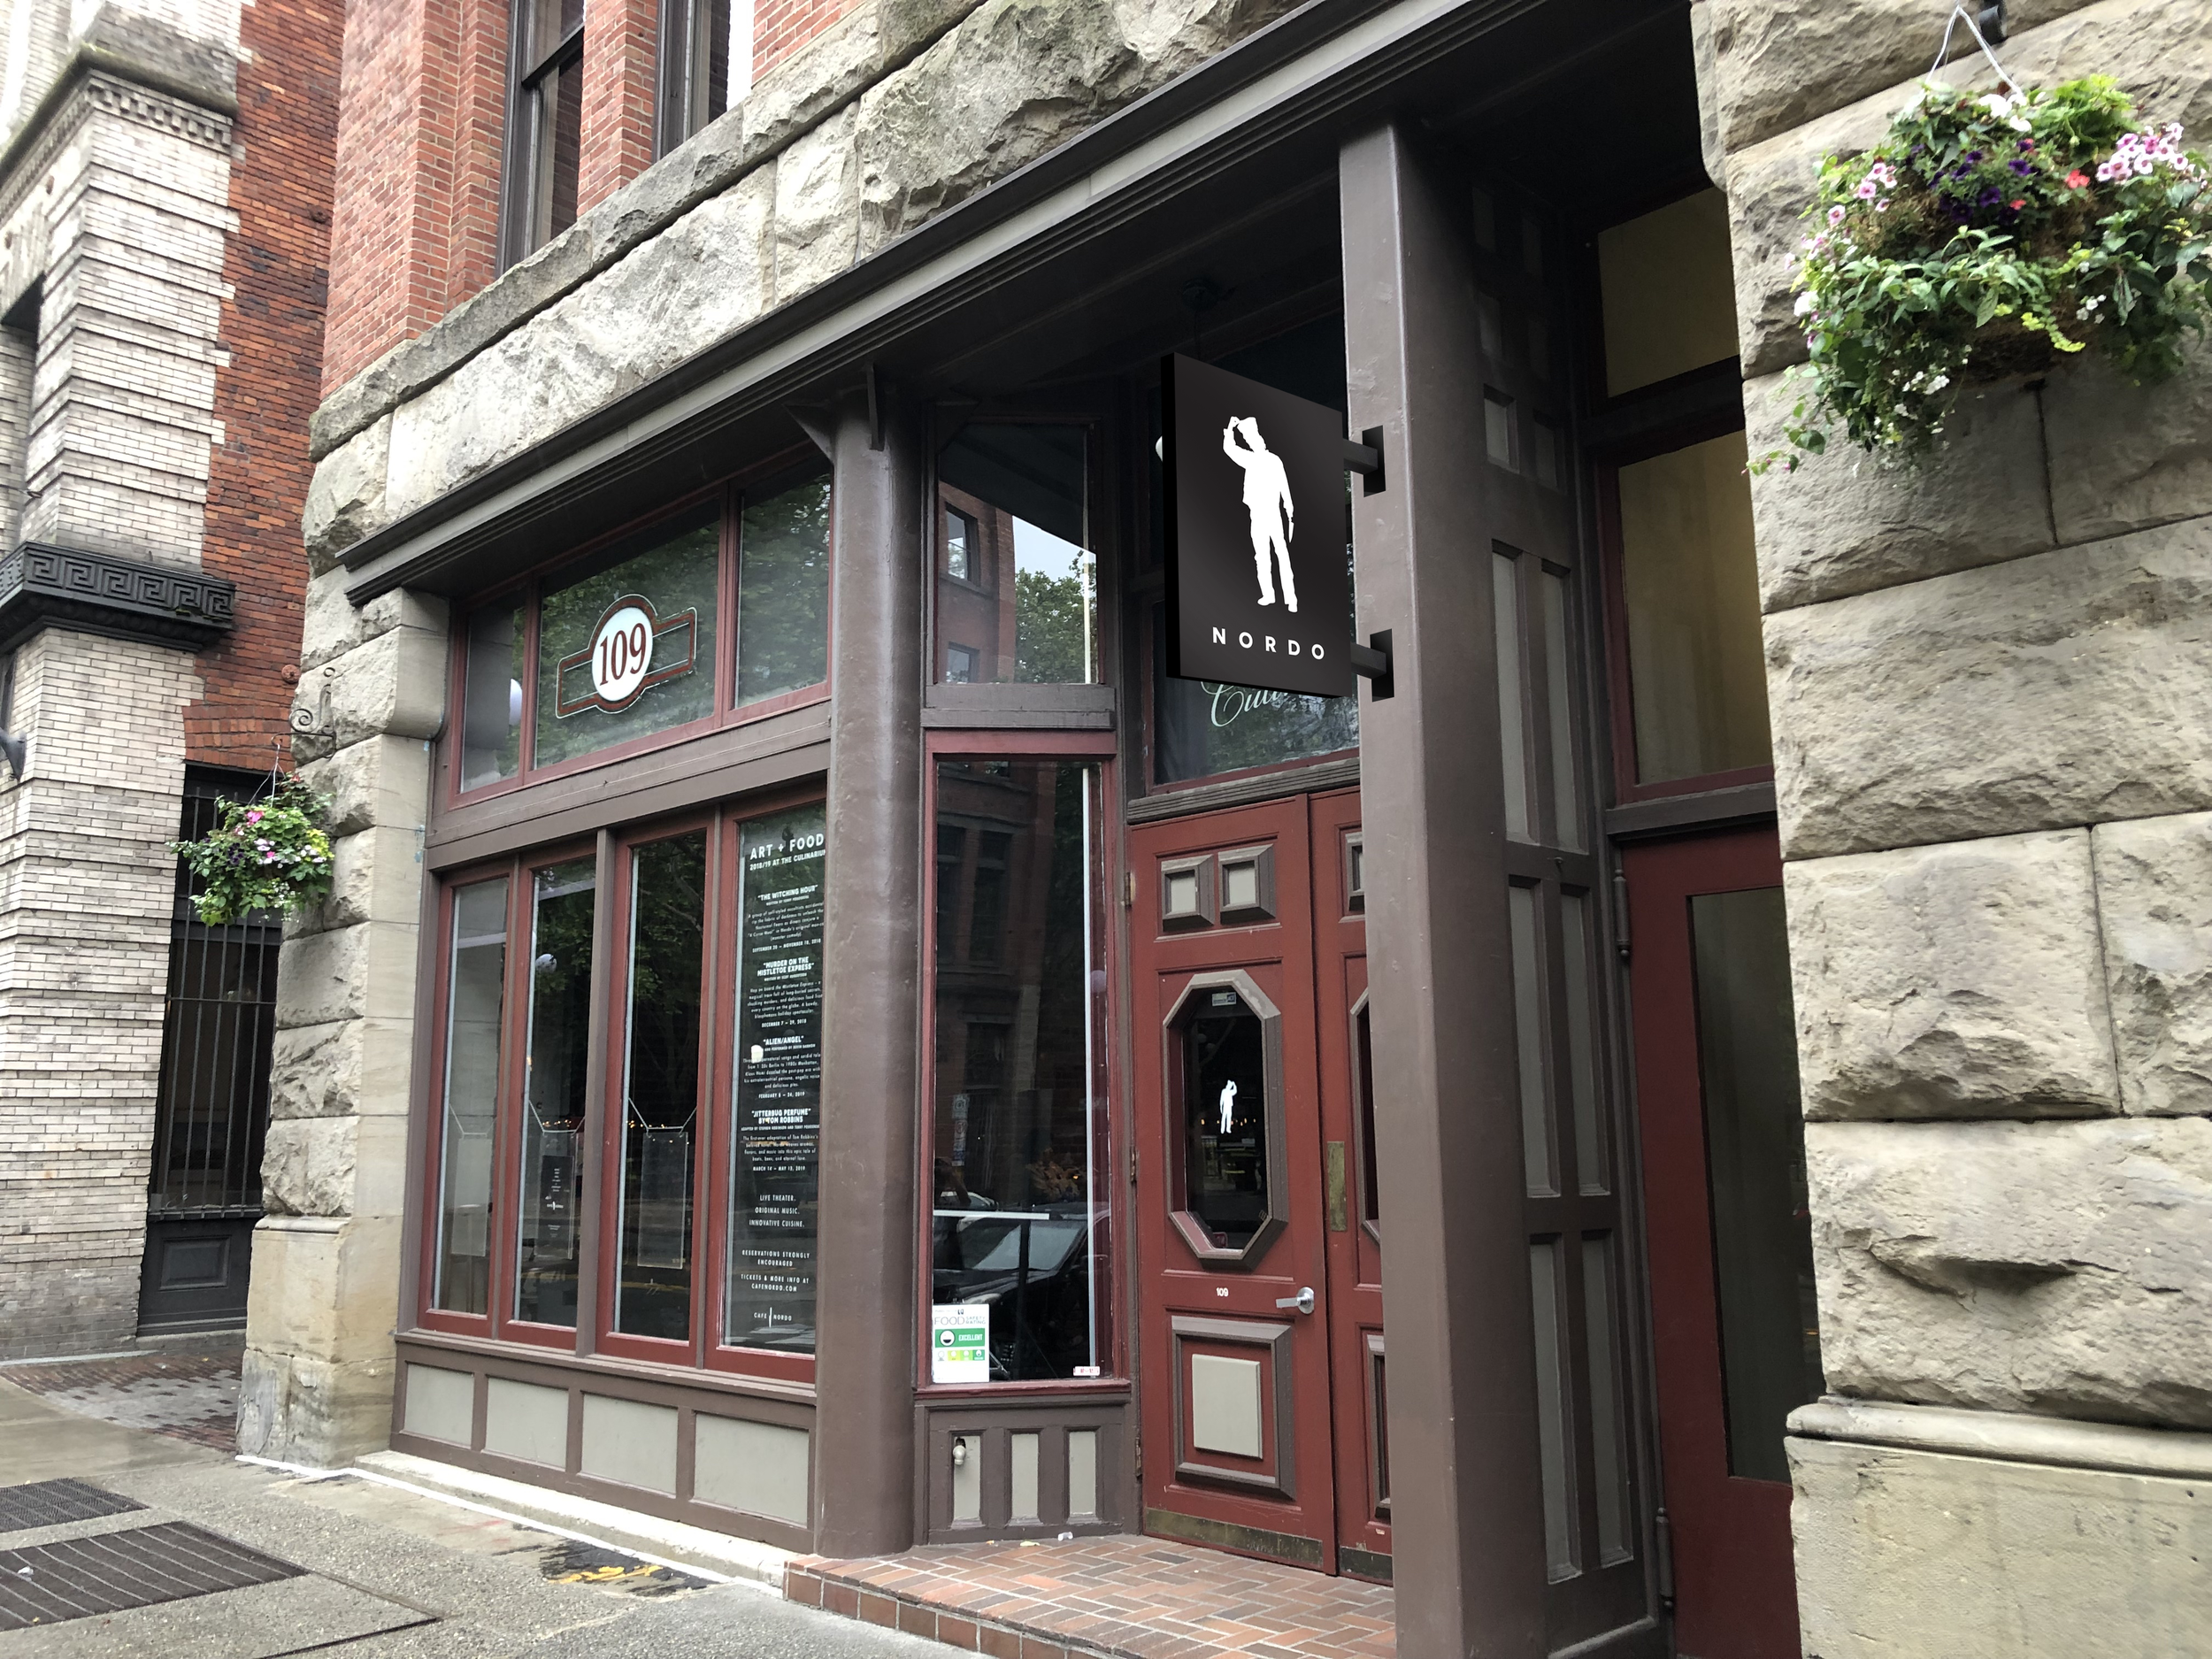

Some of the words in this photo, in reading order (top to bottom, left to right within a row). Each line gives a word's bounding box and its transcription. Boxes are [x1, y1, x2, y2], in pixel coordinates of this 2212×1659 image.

[1211, 626, 1325, 661] NORDO
[600, 623, 646, 687] 109
[749, 843, 772, 860] ART
[789, 833, 824, 852] FOOD
[749, 860, 771, 871] 2018/19
[781, 856, 792, 864] THE
[772, 887, 799, 899] WITCHING
[757, 966, 787, 977] MISTLETOE
[751, 1283, 797, 1292] CAFENORDO.COM
[1216, 1287, 1229, 1297] 109
[934, 1317, 965, 1325] FOOD
